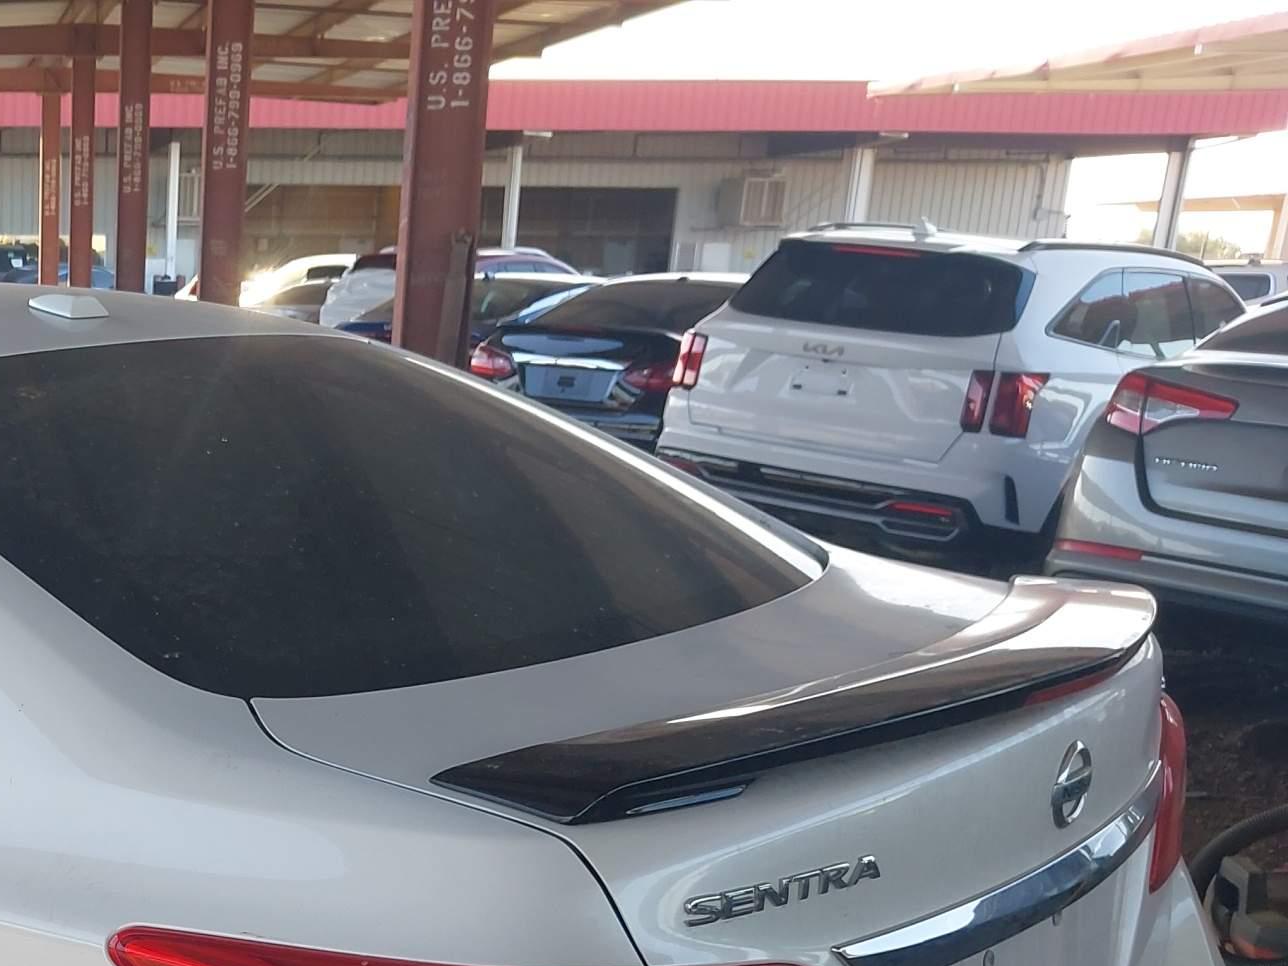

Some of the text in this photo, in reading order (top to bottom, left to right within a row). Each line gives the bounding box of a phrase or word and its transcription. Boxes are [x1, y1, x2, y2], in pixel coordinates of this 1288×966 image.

[451, 0, 475, 108] 1-866-7
[214, 77, 228, 135] PREFAB
[427, 64, 448, 110] U.S.
[683, 854, 881, 927] SENTRA
